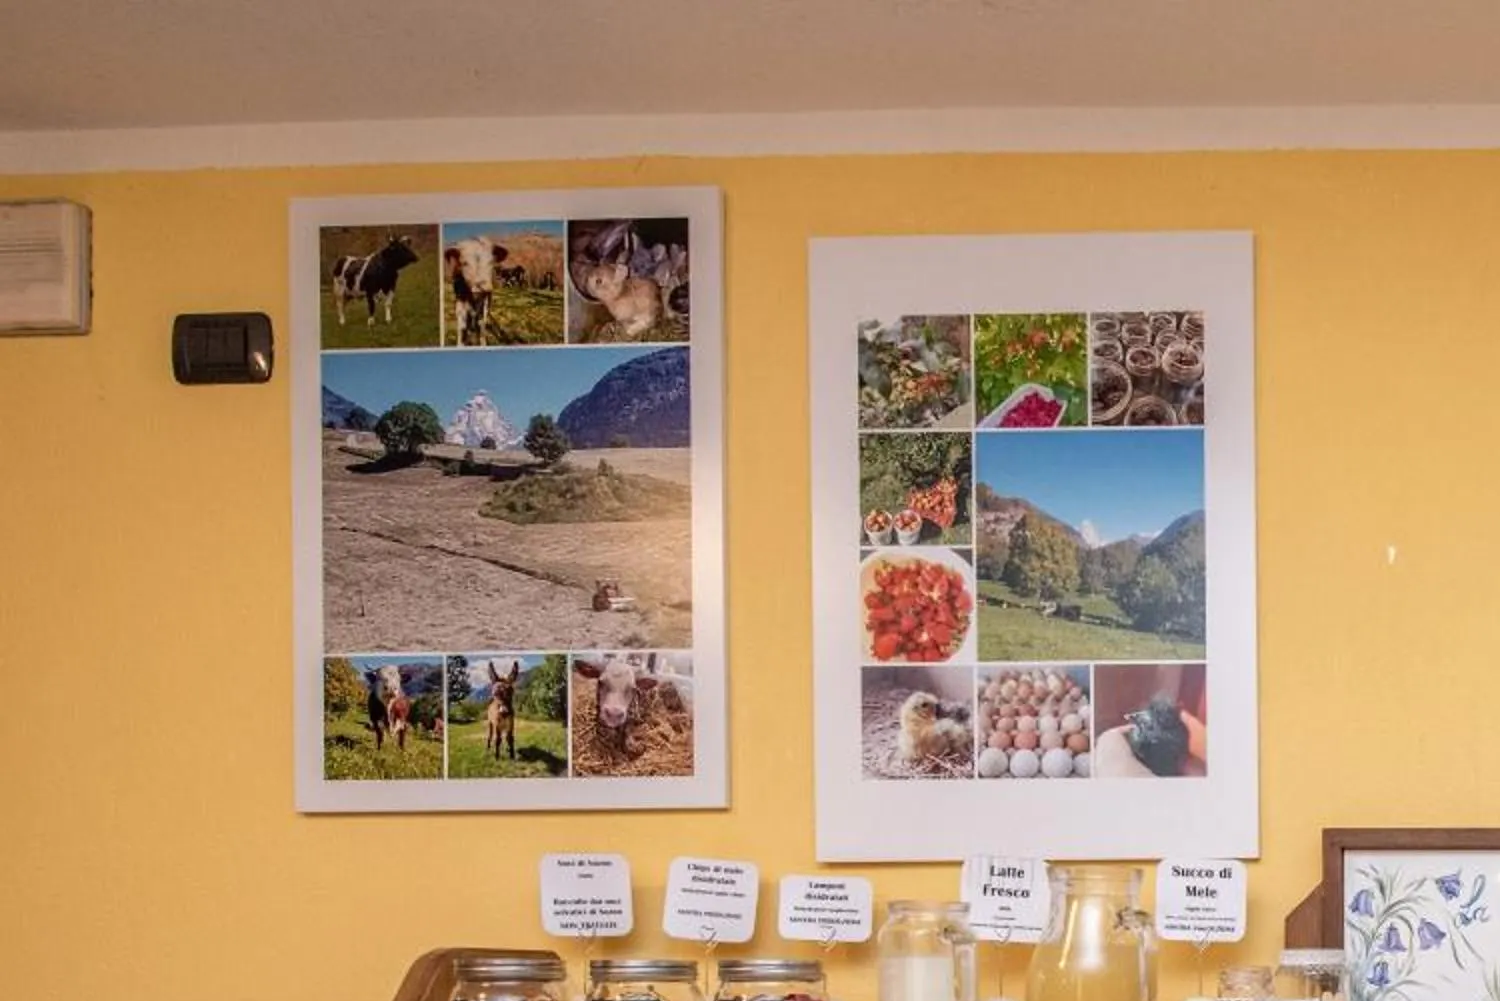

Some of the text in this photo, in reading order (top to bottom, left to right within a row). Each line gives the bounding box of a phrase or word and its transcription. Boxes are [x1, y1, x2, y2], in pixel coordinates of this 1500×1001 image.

[989, 864, 1026, 879] Latte
[1170, 865, 1233, 879] Succo di
[982, 882, 1031, 899] Fresco
[1184, 885, 1218, 899] Mele
